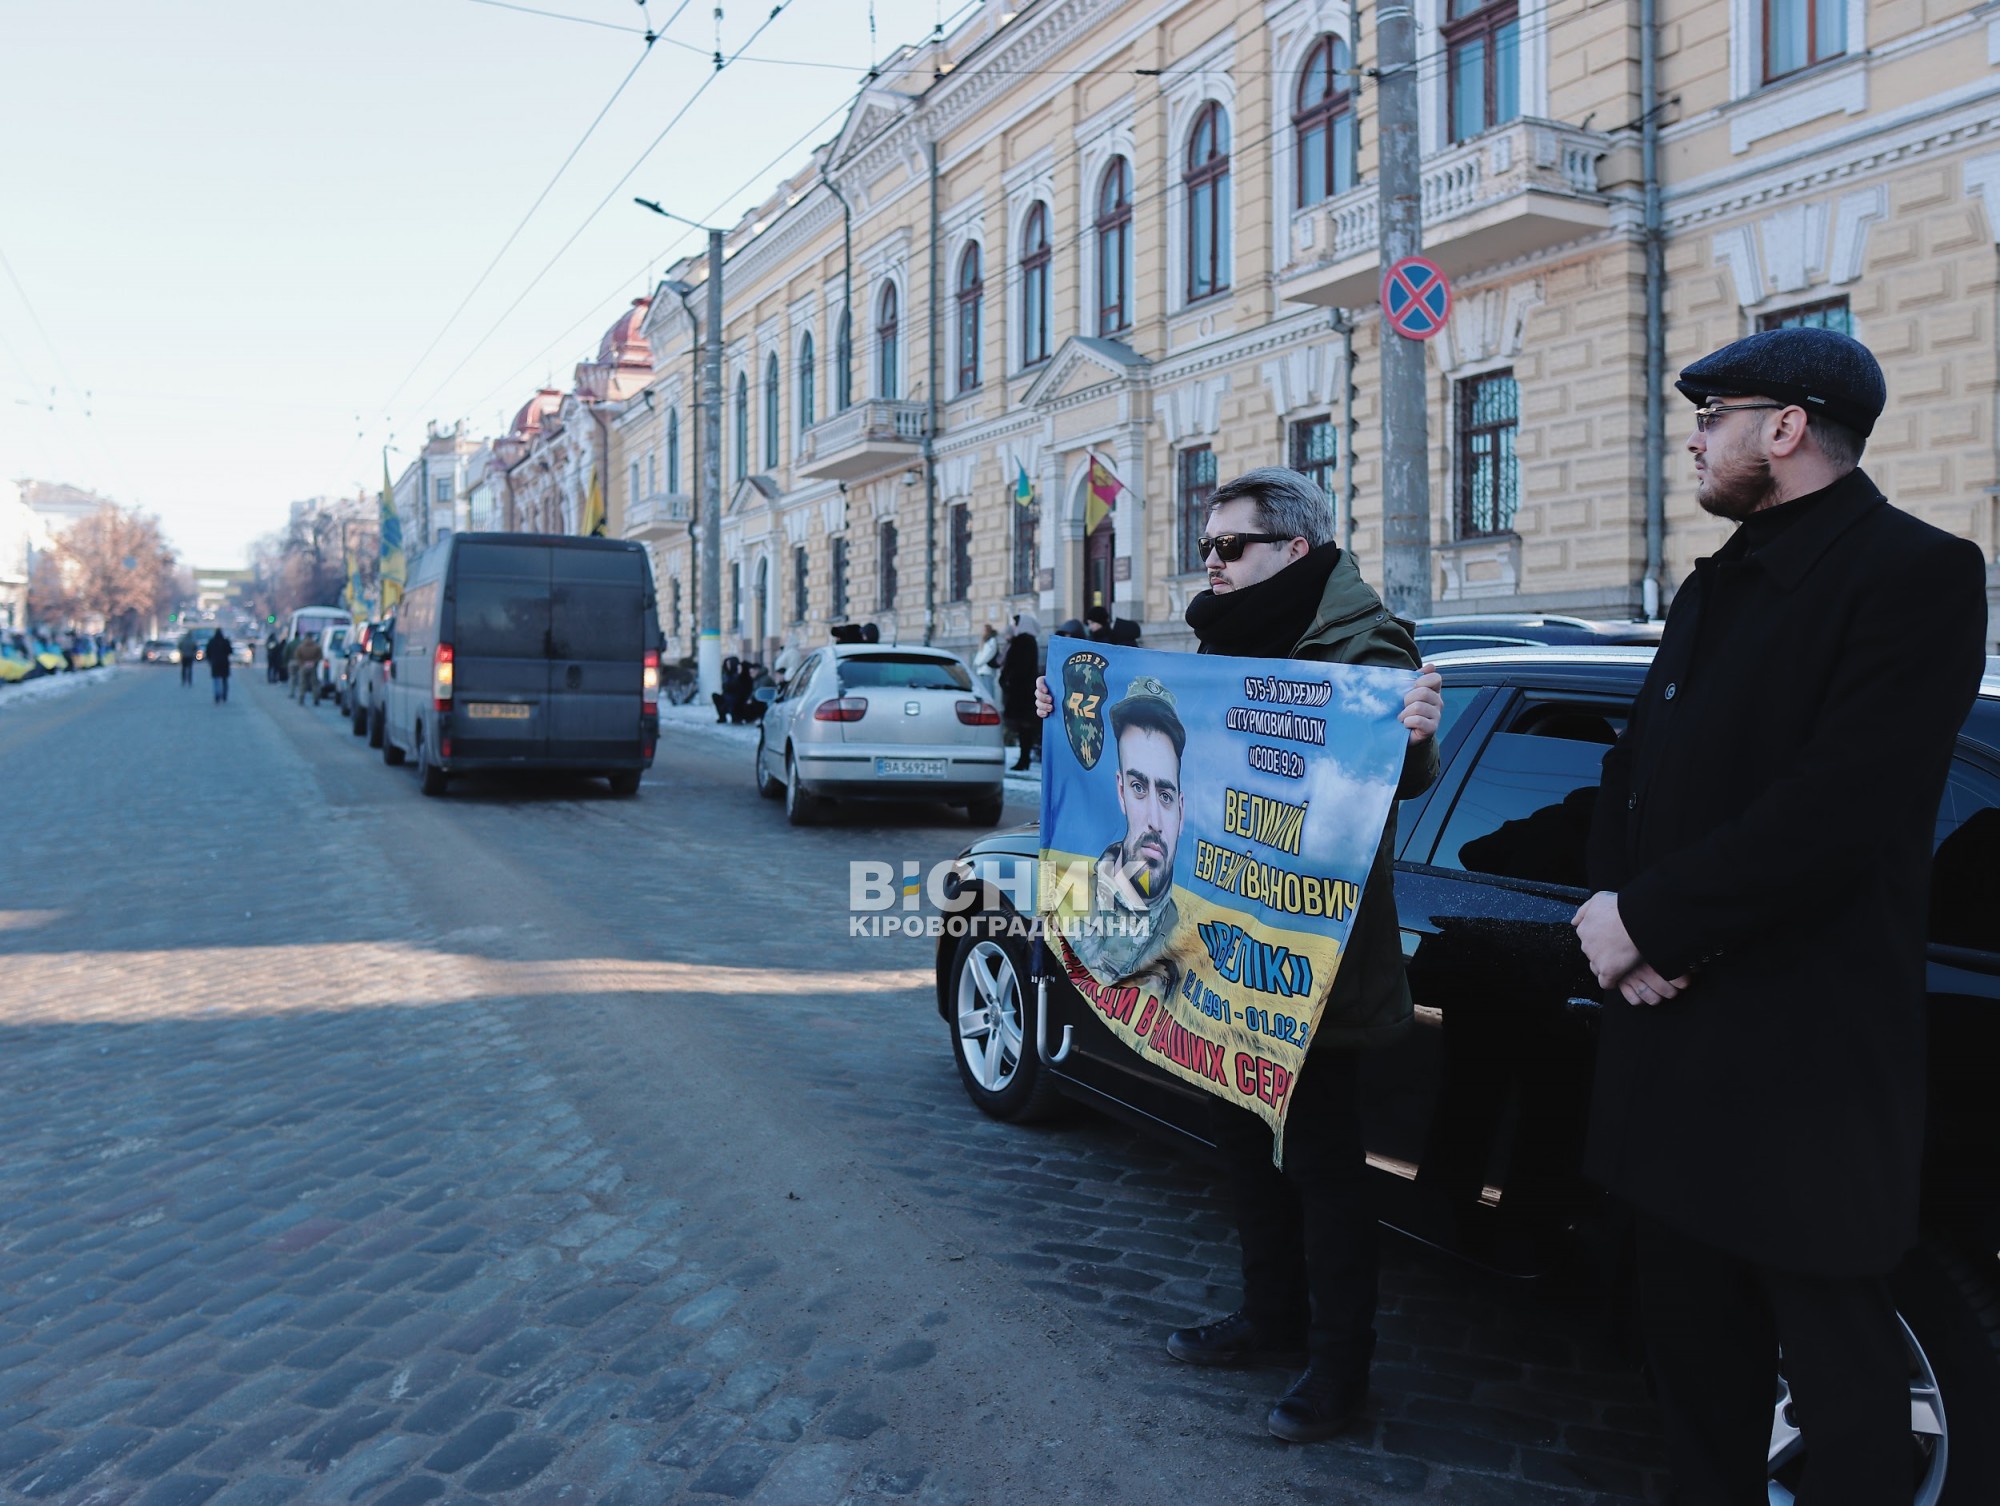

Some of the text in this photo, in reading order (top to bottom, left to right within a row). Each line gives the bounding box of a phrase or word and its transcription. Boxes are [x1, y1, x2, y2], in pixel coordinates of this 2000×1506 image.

[1068, 653, 1092, 666] CODE
[1068, 691, 1101, 719] 9.2
[1244, 676, 1332, 707] 475-Й ОКРЕМИЙ
[1226, 707, 1327, 746] ШТУРМОВИЙ ПОЛК
[1239, 855, 1359, 922] ІВАНОВИЧ
[1134, 994, 1159, 1037] В
[1149, 1004, 1229, 1088] НАШИХ
[1235, 1051, 1294, 1118] СЕР
